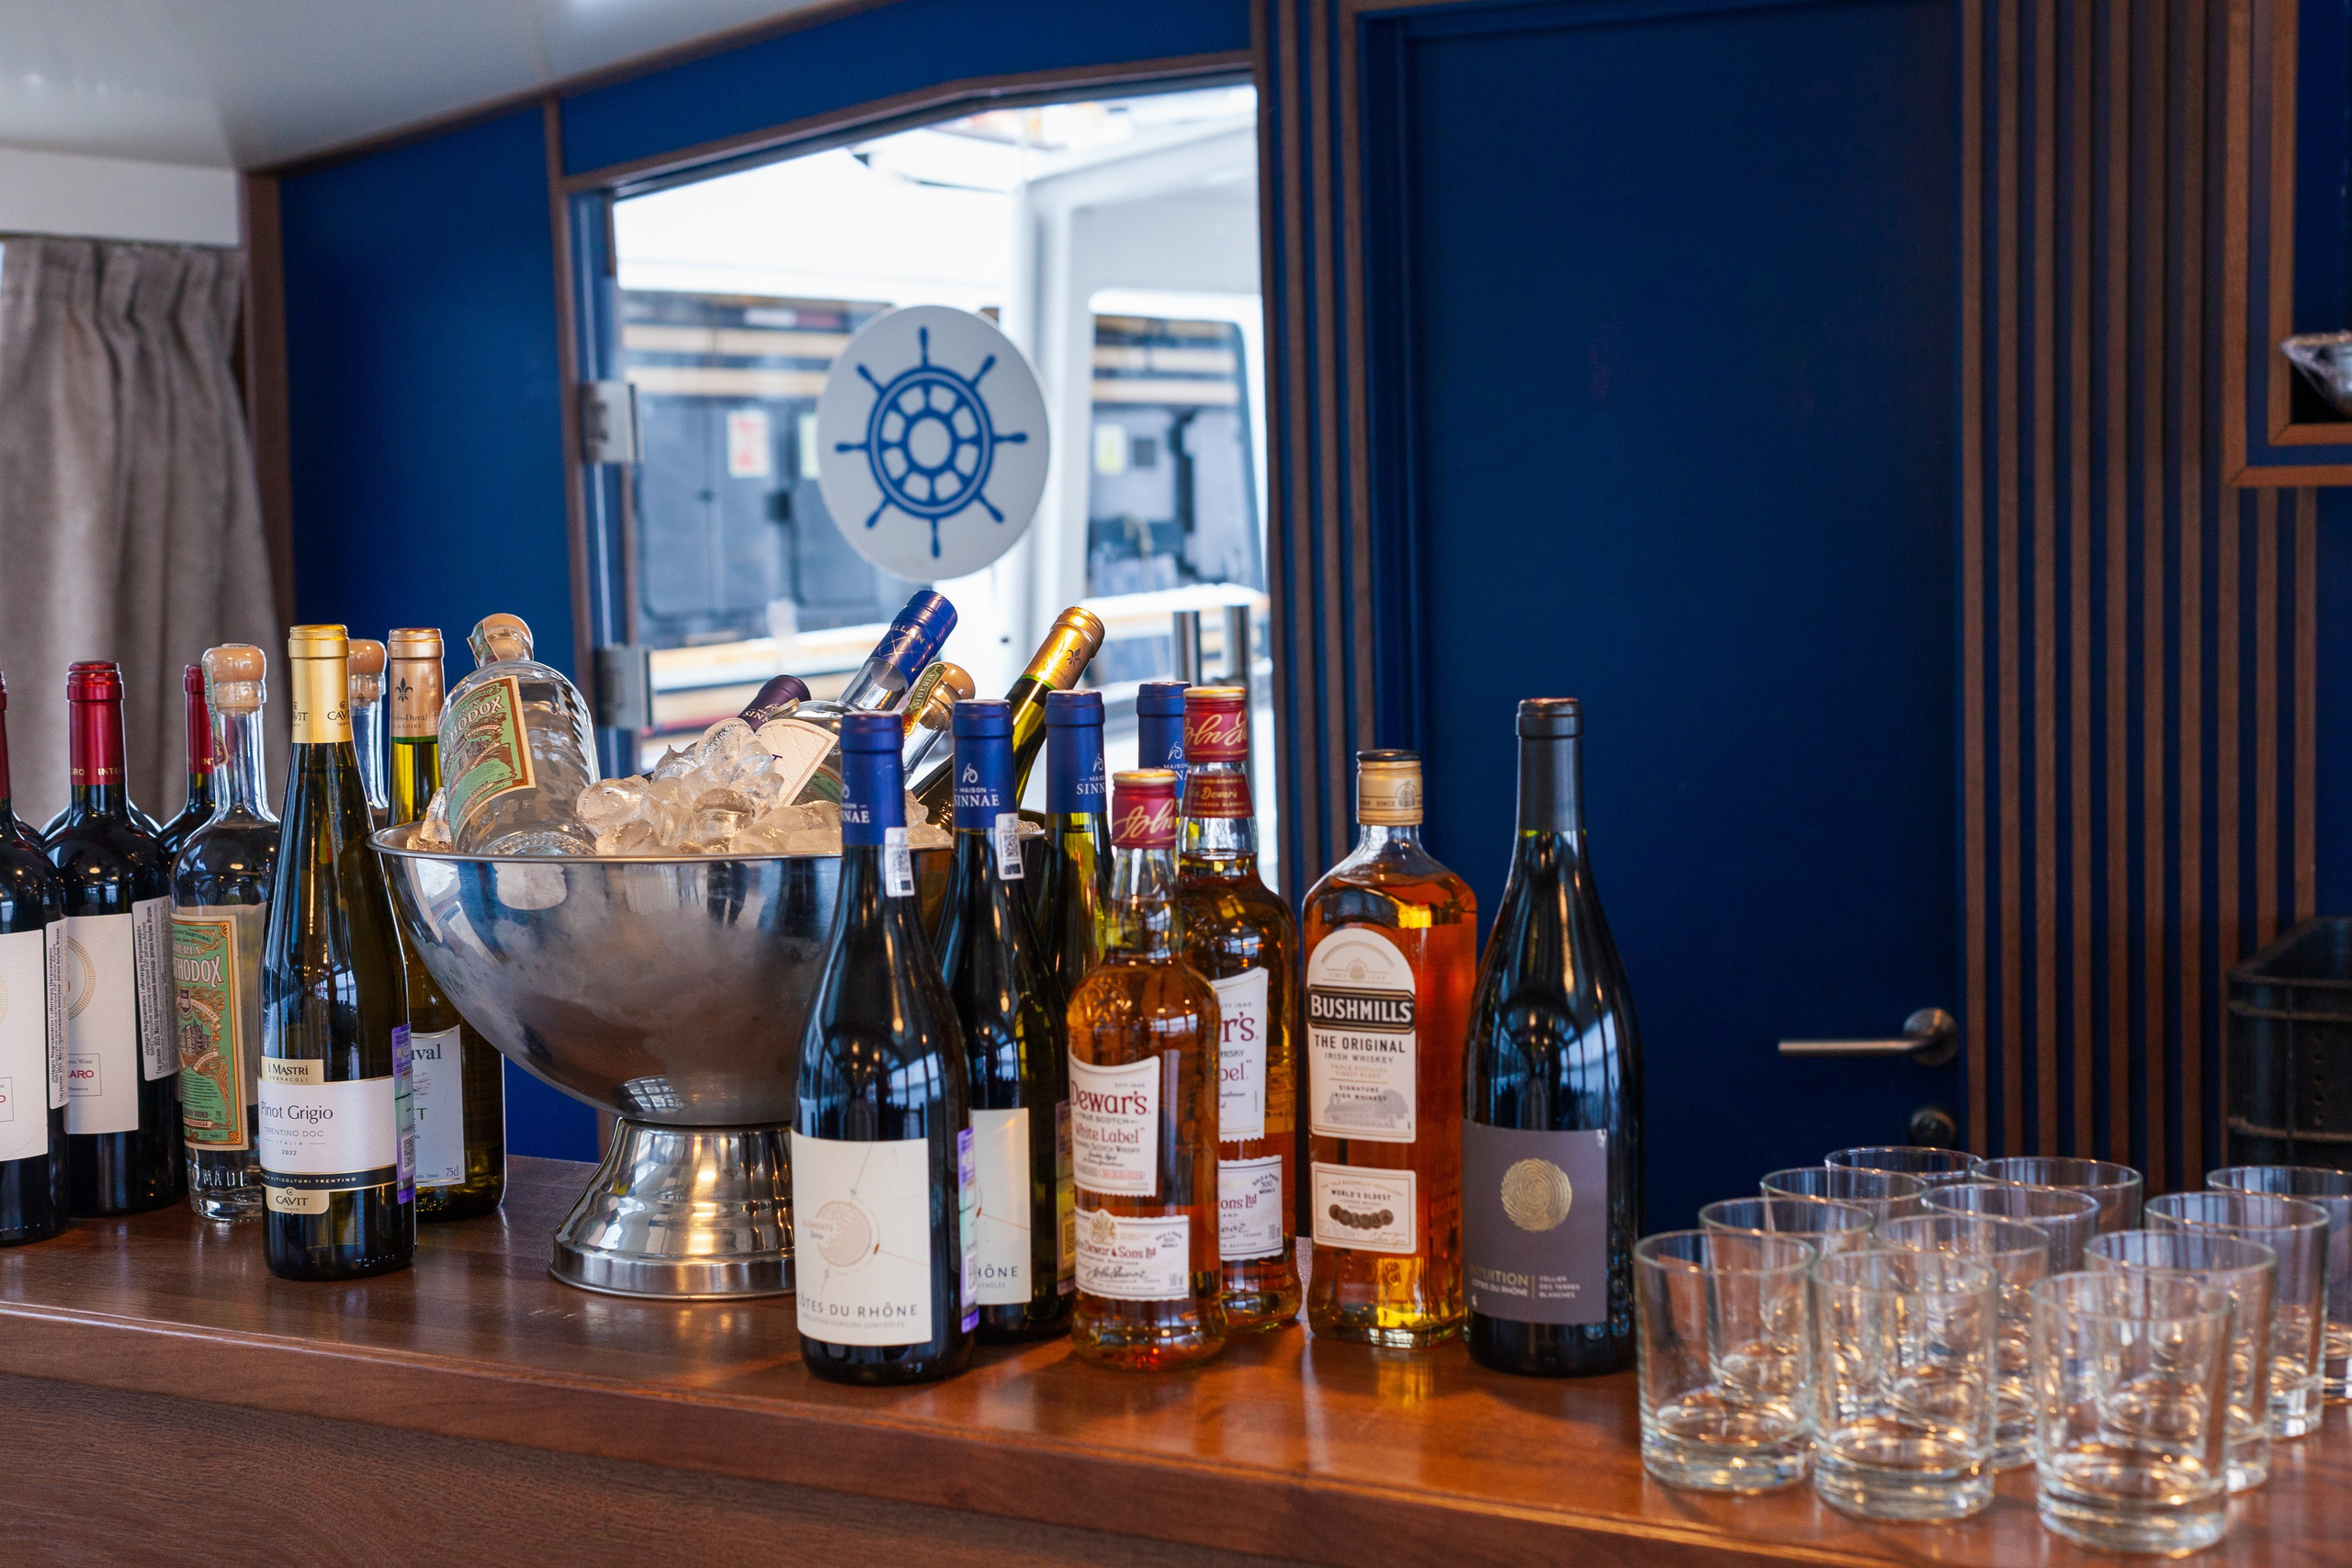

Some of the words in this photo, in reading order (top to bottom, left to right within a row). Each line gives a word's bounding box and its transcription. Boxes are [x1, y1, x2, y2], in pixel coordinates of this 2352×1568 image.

[1310, 995, 1412, 1022] BUSHMILLS
[1315, 1034, 1337, 1049] THE
[1342, 1037, 1406, 1054] ORIGINAL
[1325, 1053, 1348, 1061] IRISH
[1352, 1055, 1394, 1064] WHISKEY
[1070, 1080, 1148, 1115] Dewar's
[288, 1105, 334, 1124] Grigio
[265, 1127, 300, 1137] TRENTINO
[276, 1195, 309, 1206] CAVIT
[1331, 1189, 1362, 1199] WORLD'S
[1363, 1193, 1391, 1201] OLDEST
[1118, 1245, 1144, 1259] Sons
[829, 1303, 850, 1317] DU
[857, 1302, 919, 1318] RHÔNE
